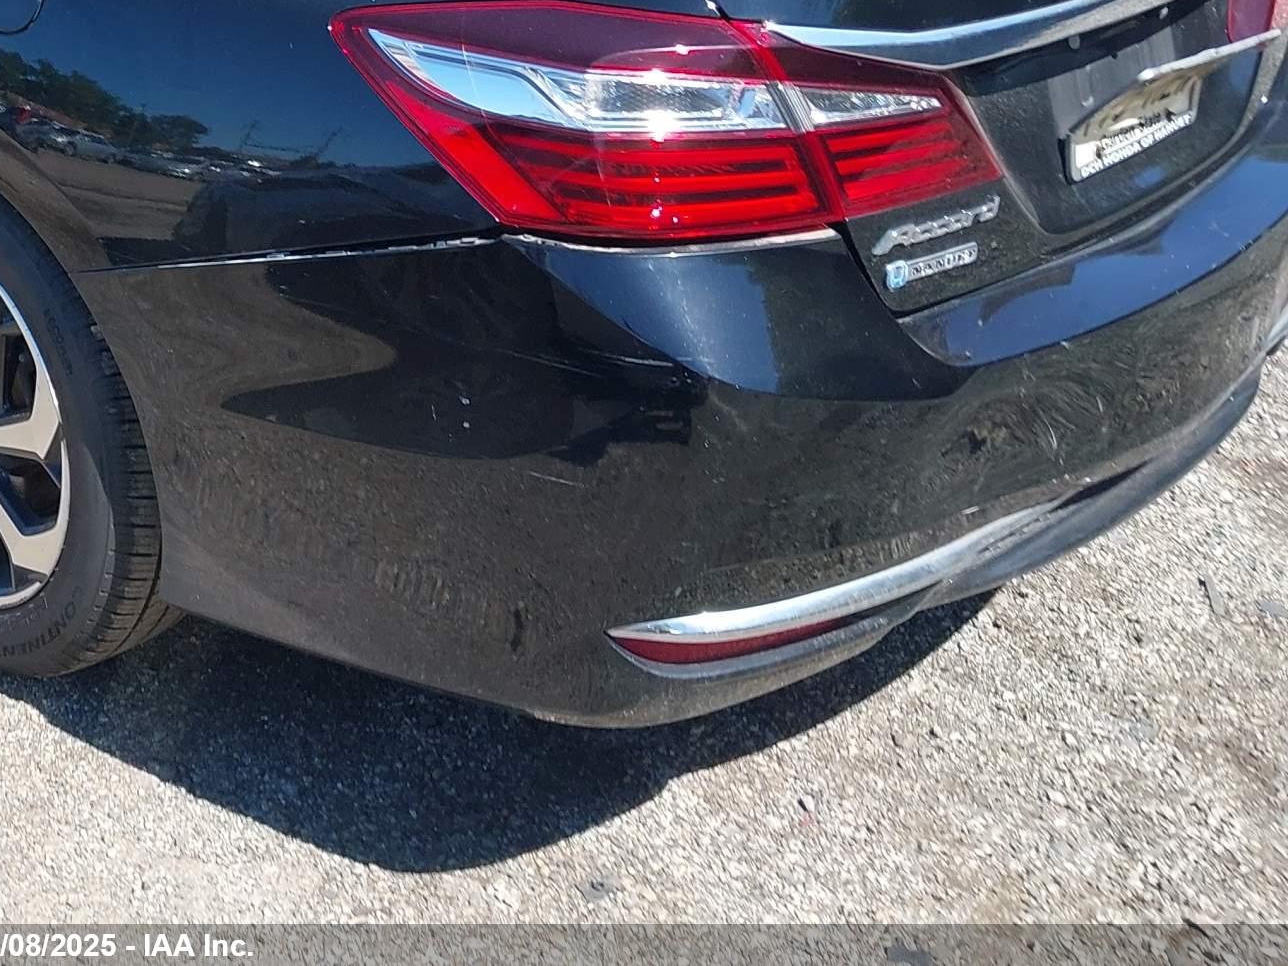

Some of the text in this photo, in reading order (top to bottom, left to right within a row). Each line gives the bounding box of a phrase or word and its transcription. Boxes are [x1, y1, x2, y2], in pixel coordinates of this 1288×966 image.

[1102, 141, 1142, 167] HONDA
[1140, 133, 1155, 148] OF
[871, 194, 1001, 256] Accord
